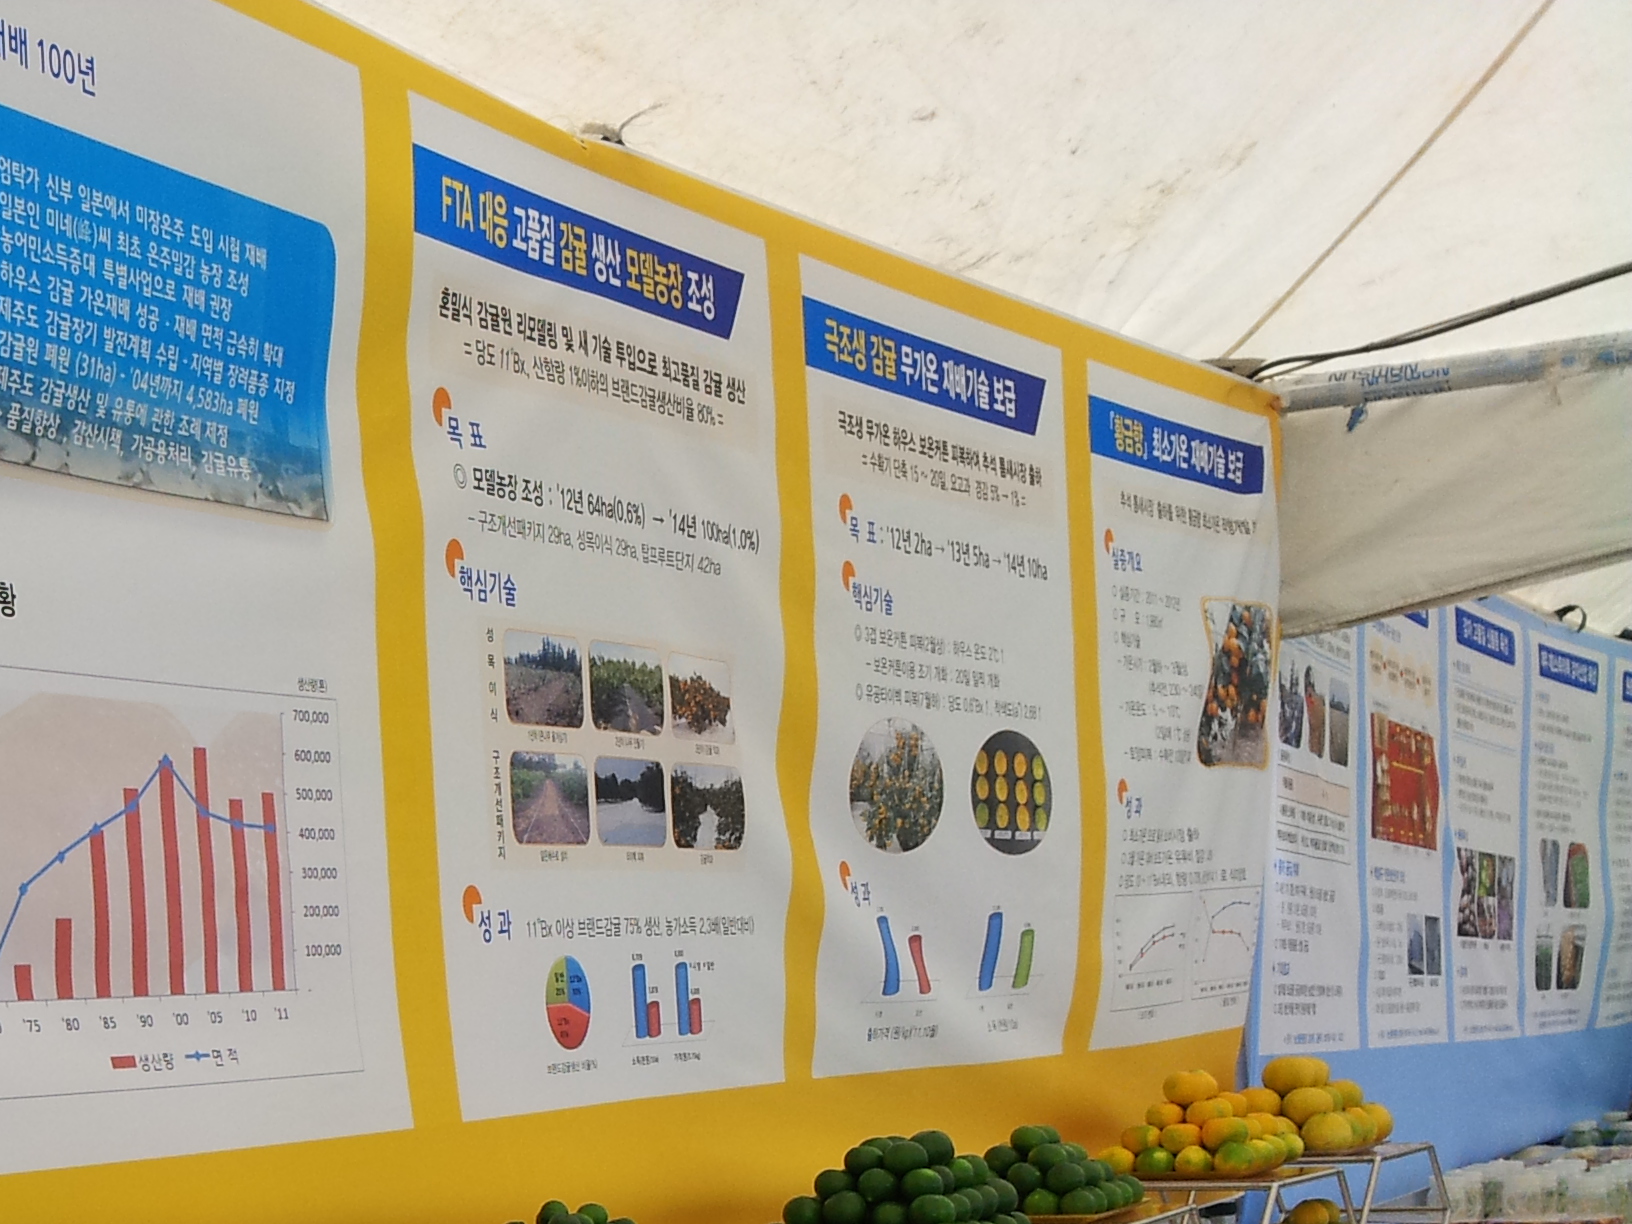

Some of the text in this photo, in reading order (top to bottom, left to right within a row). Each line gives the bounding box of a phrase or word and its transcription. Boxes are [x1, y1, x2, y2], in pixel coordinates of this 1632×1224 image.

[38, 39, 95, 96] 100년
[46, 173, 73, 204] 신부
[78, 185, 129, 224] 일본에서
[136, 206, 184, 242] 미장온주
[190, 225, 212, 254] 도입
[218, 235, 239, 263] 시험
[0, 192, 39, 229] 일본인
[117, 231, 141, 259] 최초
[147, 242, 195, 279] 온주밀감
[200, 259, 222, 288] 농장
[227, 269, 248, 297] 조성
[442, 176, 714, 320] FTA 대응 고품질 감귤 생산 모델농장 조성
[0, 225, 95, 278] 농어민소득증대
[102, 259, 176, 301] 특별사업으로
[182, 285, 205, 312] 재배
[210, 294, 232, 322] 권장
[0, 260, 41, 294] 하우스
[48, 276, 74, 307] 감귤
[80, 286, 130, 322] 가온재배
[136, 303, 159, 332] 성공
[174, 315, 196, 342] 재배
[202, 324, 223, 351] 면적
[227, 331, 259, 361] 급속히
[263, 342, 283, 368] 확대
[45, 310, 97, 346] 감귤장기
[104, 326, 151, 363] 발전계획
[155, 343, 179, 371] 수립
[191, 353, 223, 384] 지역별
[228, 365, 268, 397] 장려품종
[274, 378, 295, 404] 지정
[825, 319, 1015, 418] 극조생 감귤 무가온 재배기술 보급
[44, 343, 70, 374] 폐원
[76, 351, 116, 387] (31ha)
[186, 385, 233, 416] 4,583ha
[237, 398, 258, 424] 폐원
[473, 468, 517, 501] 모델농장
[588, 493, 645, 529] 64ha(0.6%)
[915, 533, 932, 556] 2ha
[459, 566, 516, 607] 핵심기술
[852, 582, 893, 615] 핵심기술
[293, 709, 329, 724] 700,000
[295, 750, 330, 763] 600,000
[296, 788, 332, 801] 500,000
[299, 828, 334, 840] 400,000
[302, 867, 337, 880] 300,000
[304, 905, 339, 917] 200,000
[306, 944, 341, 957] 100,000
[23, 1019, 40, 1032] '75
[99, 1016, 116, 1029] '85
[137, 1015, 153, 1027] '90
[173, 1013, 188, 1025] '00
[208, 1011, 222, 1023] '05
[242, 1010, 256, 1022] '10
[274, 1008, 288, 1020] '11
[139, 1053, 174, 1072] 생산량
